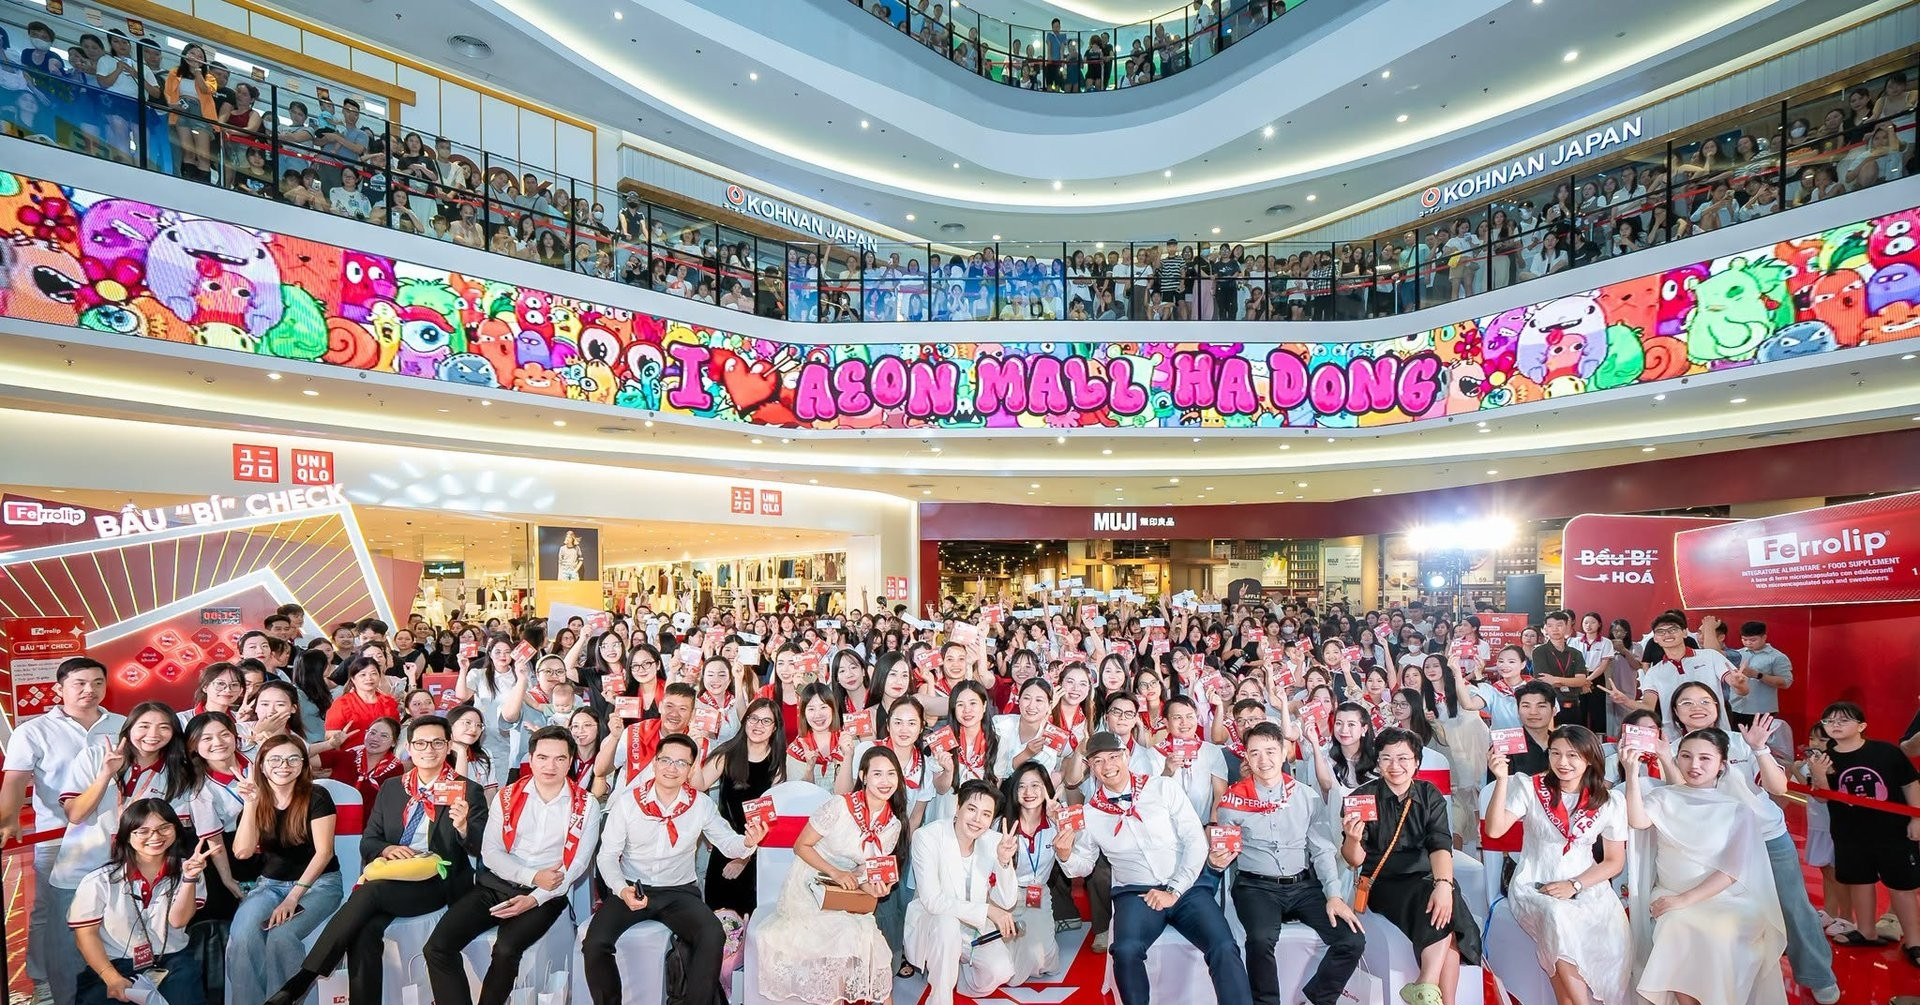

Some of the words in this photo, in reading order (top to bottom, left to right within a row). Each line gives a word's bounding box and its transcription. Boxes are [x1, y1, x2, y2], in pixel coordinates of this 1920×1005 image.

[1444, 153, 1545, 203] KOHNAN
[1551, 116, 1642, 166] JAPAN
[747, 194, 823, 235] KOHNAN
[825, 223, 878, 253] JAPAN
[666, 339, 713, 411] I
[794, 354, 958, 422] AEON
[973, 353, 1150, 416] MALL
[1170, 349, 1258, 417] HA
[1267, 347, 1443, 417] DONG
[239, 449, 272, 462] ユニ
[297, 453, 327, 469] UNI
[239, 465, 272, 477] クロ
[296, 468, 329, 482] QLO
[245, 483, 344, 514] CHECK
[762, 492, 778, 502] UNI
[8, 504, 82, 524] Ferrolip
[762, 502, 780, 513] QLO
[1094, 512, 1137, 531] MUJI
[1748, 528, 1890, 567] Ferrolip
[1581, 548, 1624, 566] Bầu
[1741, 568, 1781, 577] INTEGRATORE
[1781, 563, 1820, 573] ALIMENTARE
[1848, 556, 1901, 568] SUPPLEMENT
[1853, 566, 1894, 576] edulcoranti
[1611, 569, 1655, 584] HOÁ
[1848, 575, 1889, 583] sweeteners
